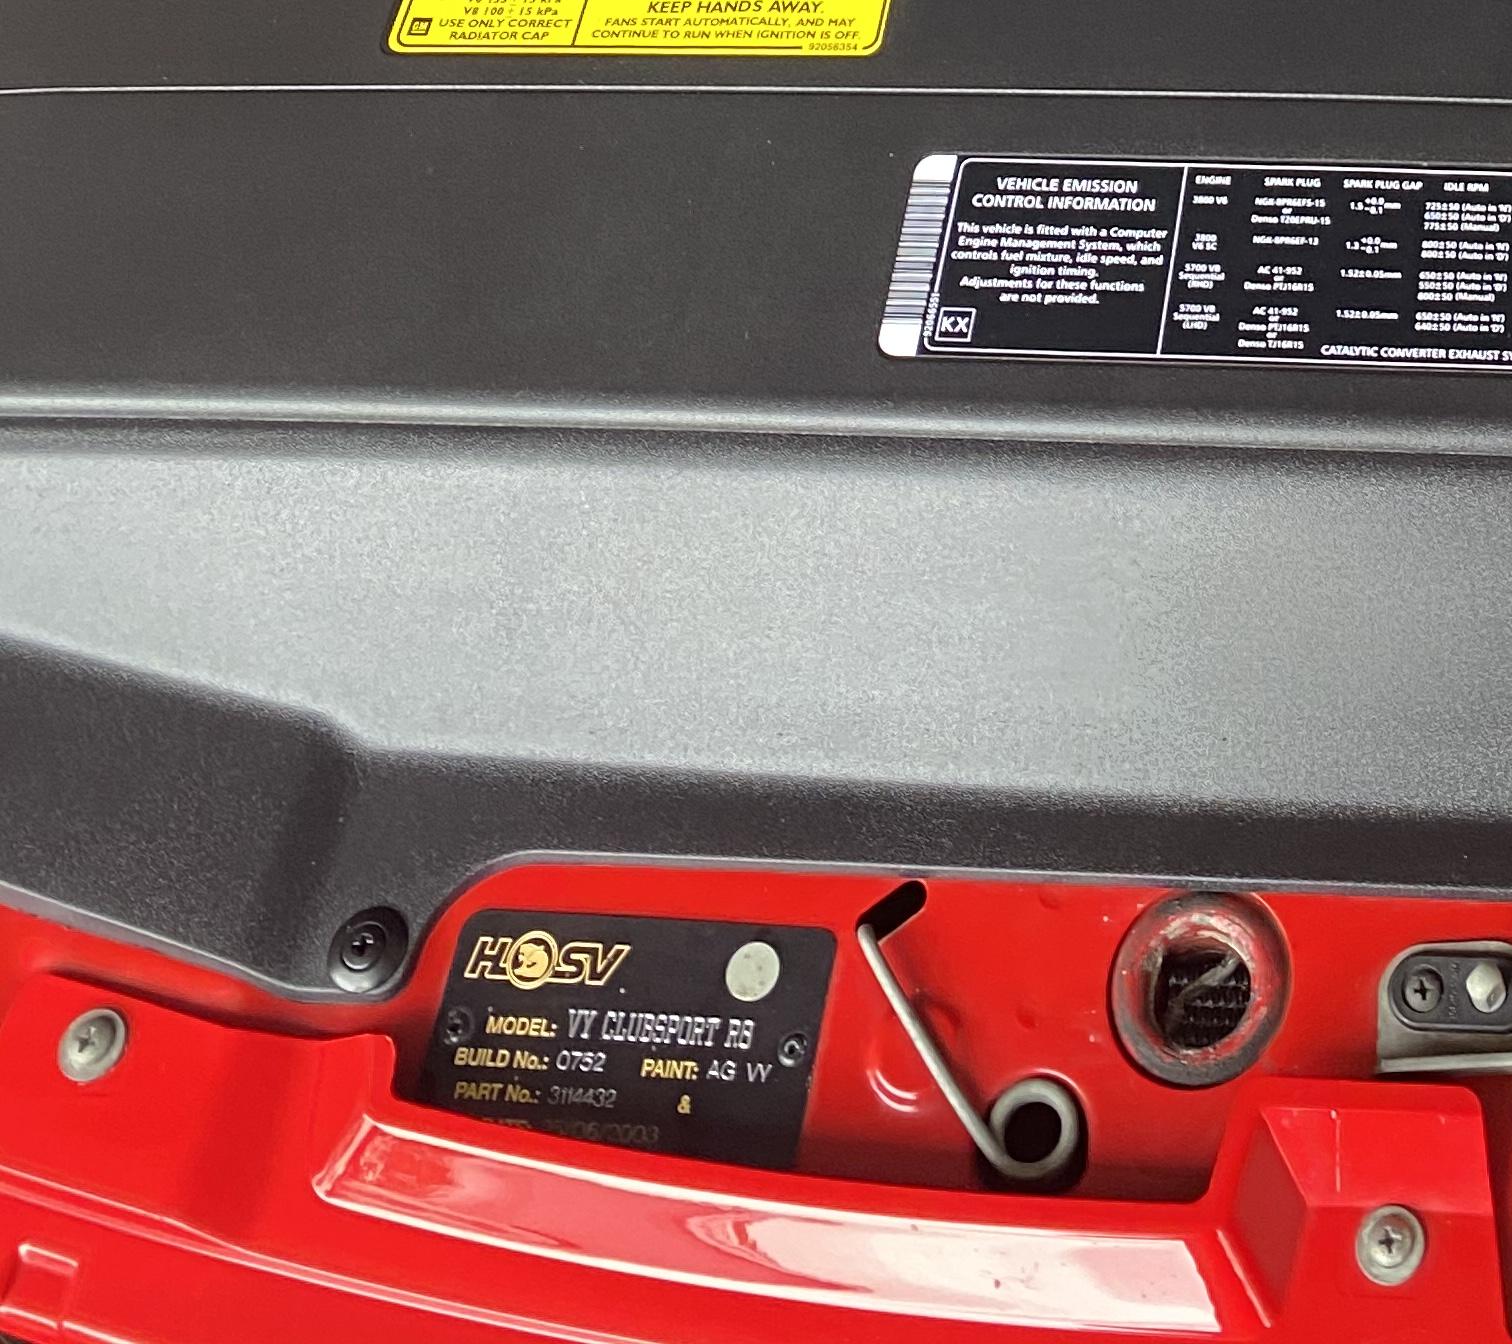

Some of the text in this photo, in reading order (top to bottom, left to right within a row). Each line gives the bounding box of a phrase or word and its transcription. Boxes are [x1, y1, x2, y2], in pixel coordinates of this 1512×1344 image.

[464, 7, 478, 15] V8
[485, 7, 503, 15] 100
[537, 7, 558, 15] kPa
[647, 1, 824, 13] KEEP HANDS AWAY.
[440, 19, 465, 27] USE
[469, 19, 504, 27] ONLY
[605, 17, 855, 28] FANS START AUTOMATICALLY, AND MAY
[450, 32, 548, 40] RADIATOR CAP
[592, 30, 657, 38] CONTINUE
[663, 31, 680, 39] TO
[684, 31, 710, 39] RUN
[715, 30, 752, 39] WHEN
[757, 30, 816, 39] IGNITION
[820, 31, 830, 39] IS
[997, 177, 1138, 193] VEHICLE EMISSION
[1195, 175, 1231, 185] ENGINE
[1264, 177, 1321, 188] SPARK PLUG
[1343, 179, 1423, 190] SPARK PLUG GAP
[1444, 183, 1489, 192] IDLE RPM
[972, 194, 1156, 211] CONTROL INFORMATION
[957, 222, 1168, 240] This vehicle is fitted with a Computer
[958, 237, 1161, 251] Engine Management System, which
[951, 251, 1163, 266] controls fuel mixture, idle speed, and
[1010, 265, 1099, 278] ignition timing.
[960, 277, 1144, 292] Adjustments for these functions
[999, 293, 1099, 305] are not provided.
[941, 316, 969, 333] KX
[1321, 345, 1378, 357] CATALYTIC
[1380, 347, 1446, 358] CONVERTER
[1450, 348, 1499, 360] EXHAUST
[485, 1015, 558, 1037] MODEL:
[568, 1009, 598, 1039] VY
[601, 1011, 722, 1047] CLUBSPORT
[454, 1047, 606, 1072] BUILD No.: 0752
[640, 1058, 699, 1080] PAINT:
[706, 1060, 737, 1081] AG
[454, 1081, 503, 1099] PART
[547, 1086, 617, 1108] 3114432
[677, 1094, 692, 1114] &
